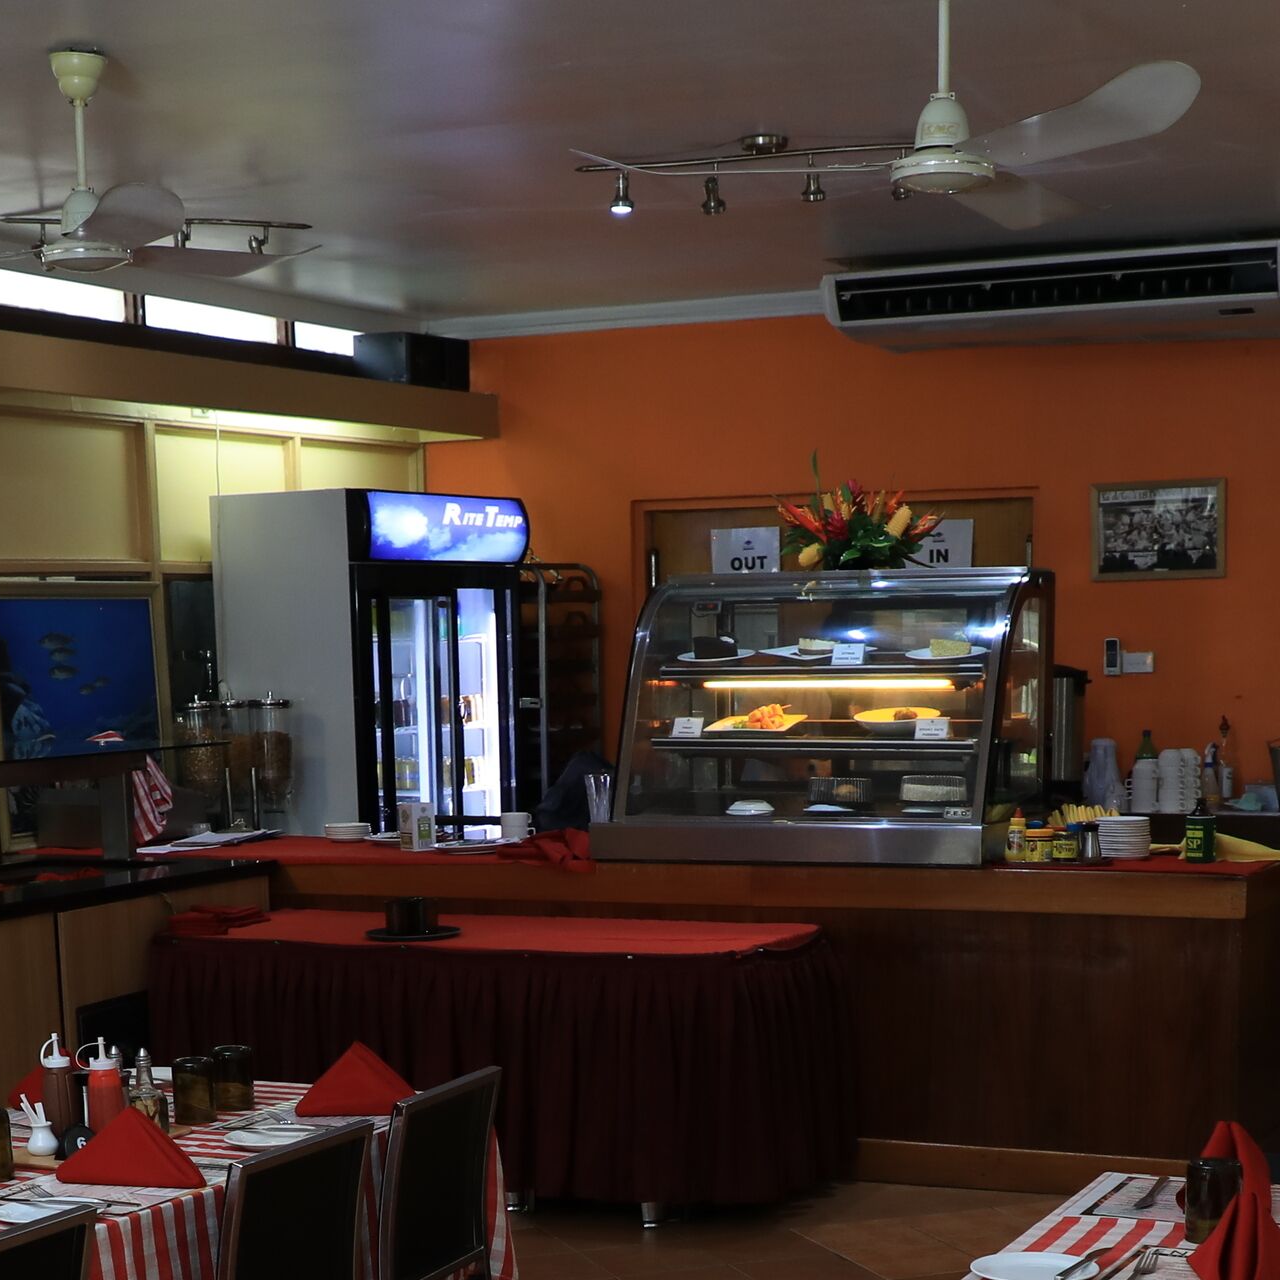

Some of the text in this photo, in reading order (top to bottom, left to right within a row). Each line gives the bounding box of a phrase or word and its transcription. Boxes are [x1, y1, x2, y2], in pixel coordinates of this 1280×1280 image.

[730, 555, 768, 571] OUT
[929, 548, 949, 564] IN
[1187, 838, 1201, 849] SP
[76, 1135, 87, 1150] 6
